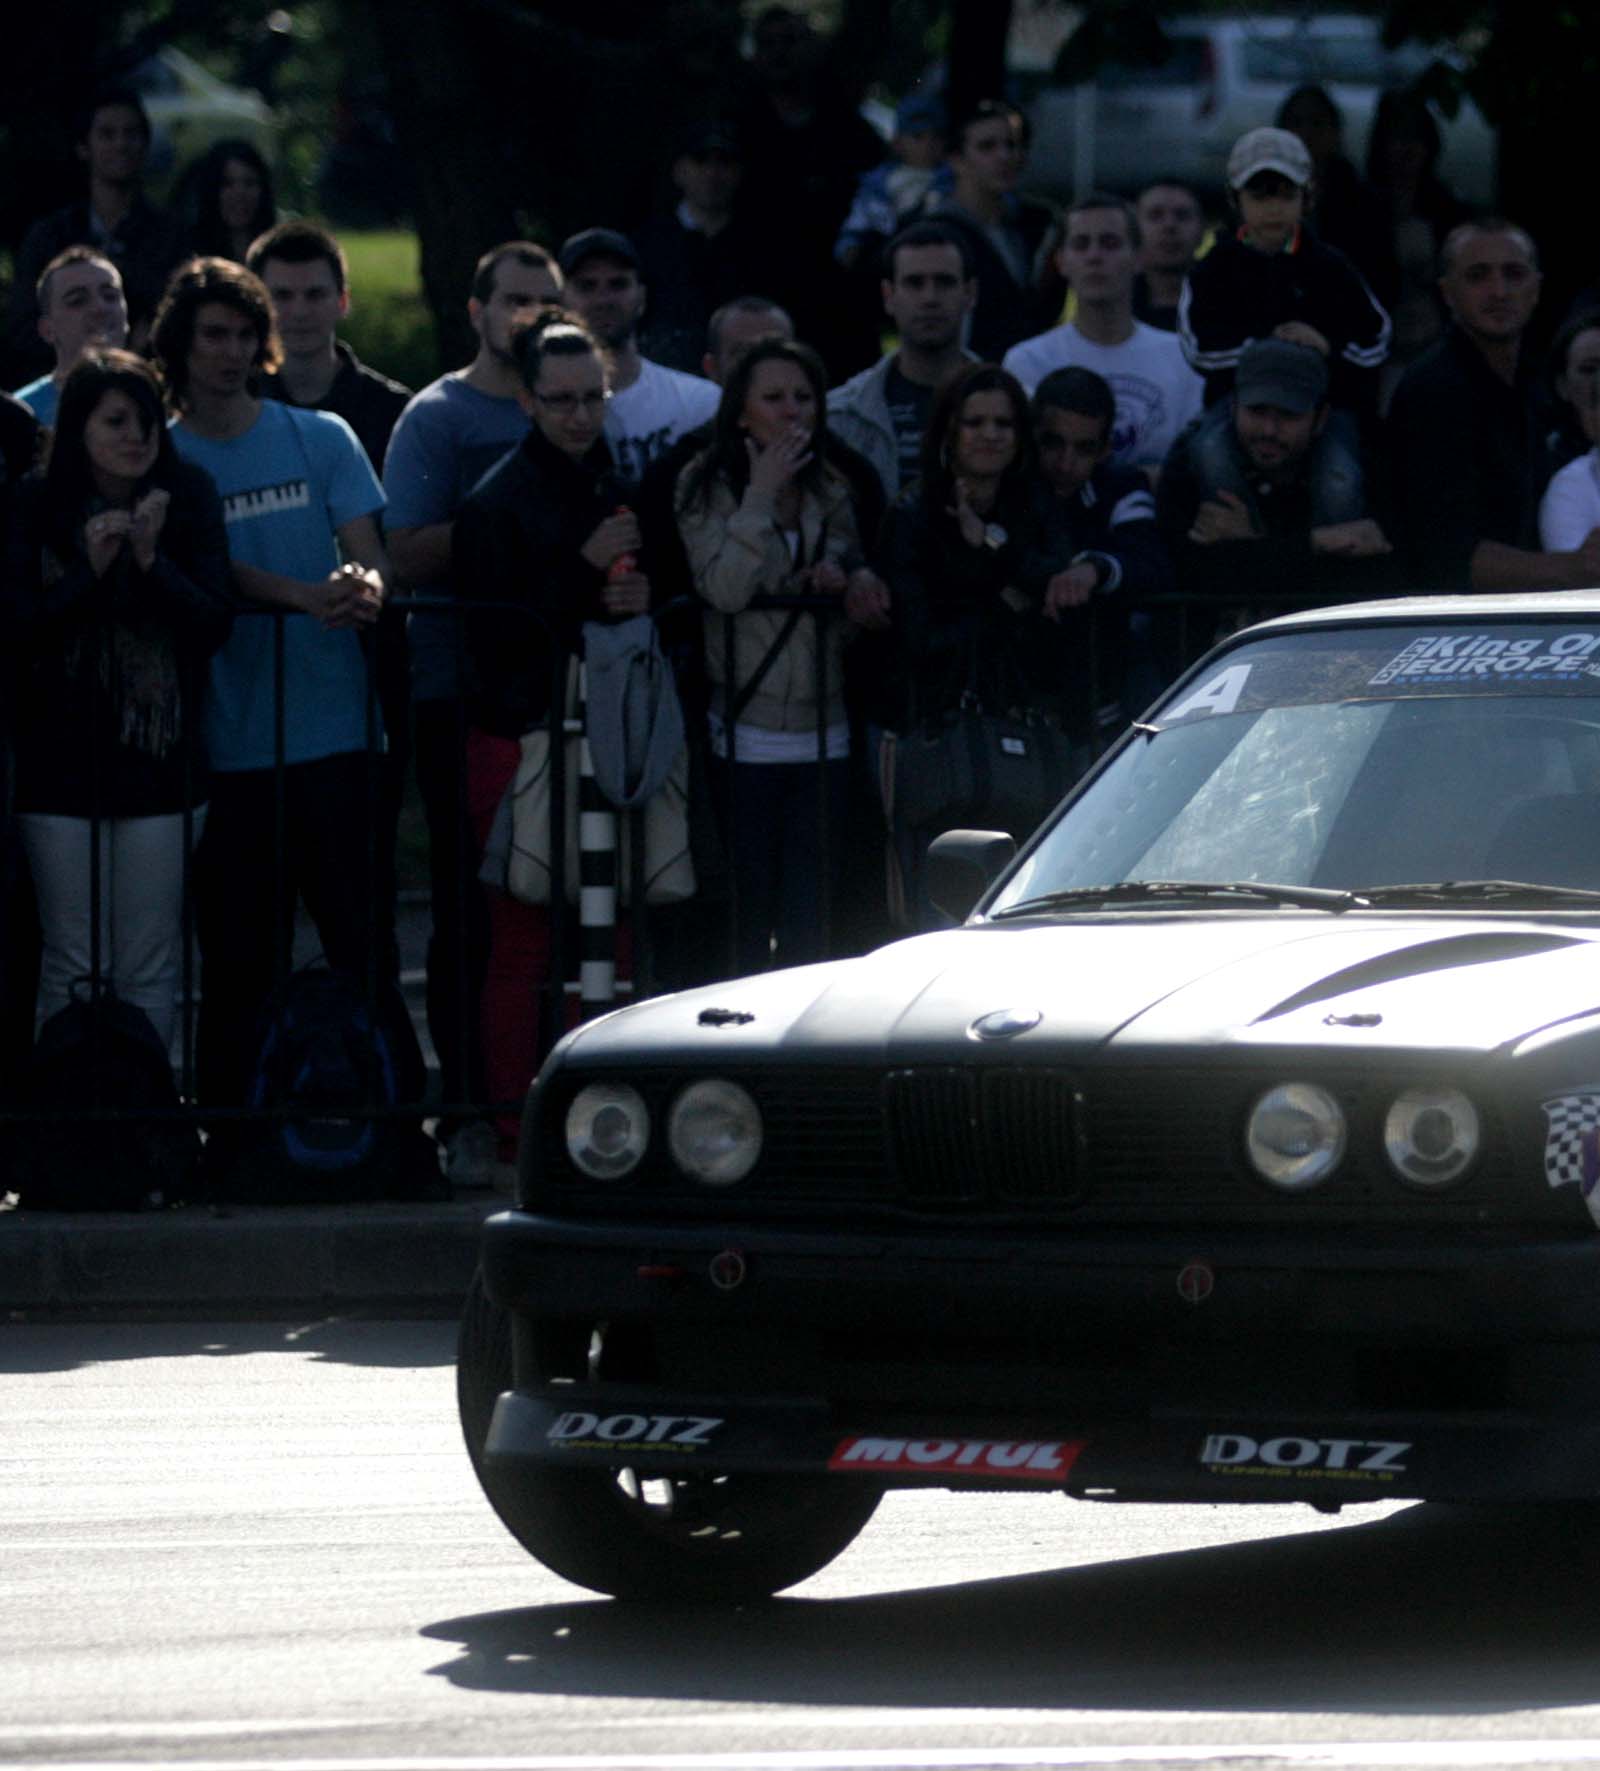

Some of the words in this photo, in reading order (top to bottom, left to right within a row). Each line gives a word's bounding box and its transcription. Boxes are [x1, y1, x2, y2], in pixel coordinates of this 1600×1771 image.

[1421, 634, 1545, 659] King
[1400, 655, 1589, 675] EUROPE
[1163, 663, 1252, 720] A
[546, 1411, 725, 1445] DOTZ
[841, 1437, 1064, 1470] MOTUL
[1200, 1434, 1413, 1472] DOTZ
